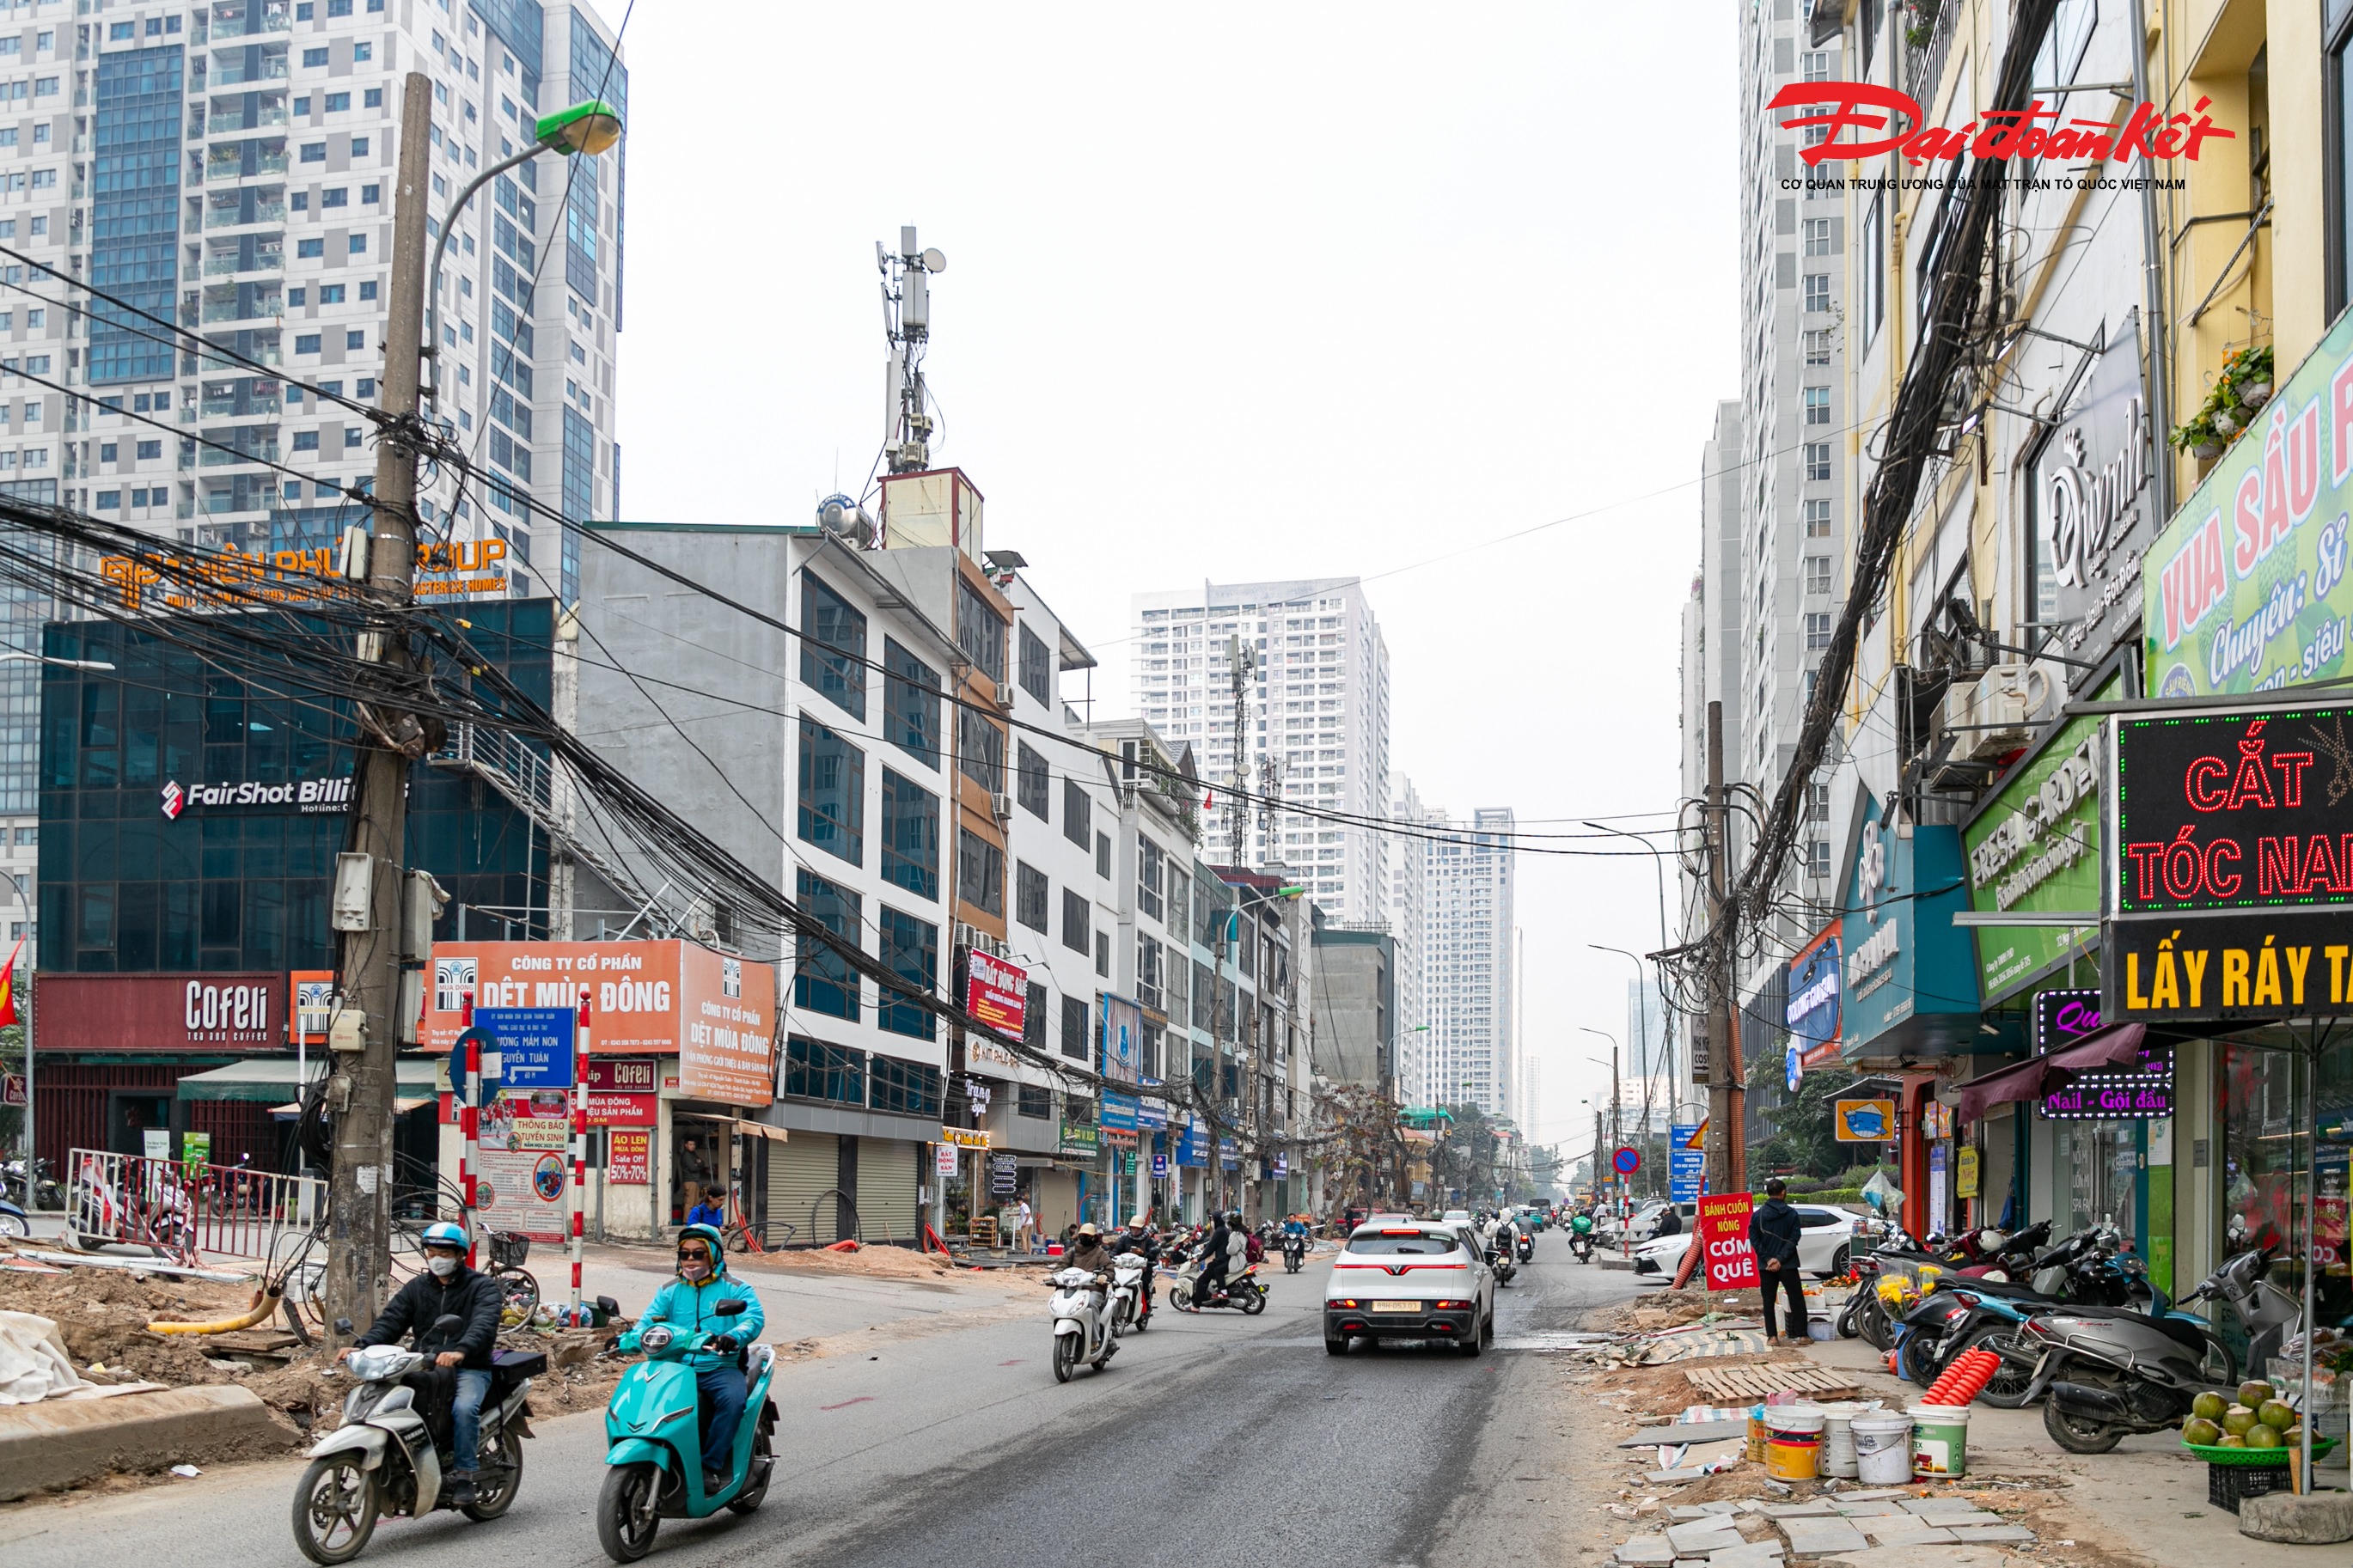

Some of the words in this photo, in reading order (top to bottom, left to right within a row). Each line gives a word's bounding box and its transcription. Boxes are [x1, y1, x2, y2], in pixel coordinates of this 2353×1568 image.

[2108, 509, 2140, 551] ACADEMY
[2160, 510, 2227, 650] VUA
[2234, 404, 2318, 577] SẦU
[2211, 574, 2306, 686] Chuyên:
[2301, 615, 2344, 679] siêu
[2184, 720, 2314, 813] CẮT
[187, 781, 293, 805] FairShot
[1971, 811, 2025, 889] FRESH
[2127, 824, 2243, 900] TÓC
[511, 955, 552, 970] CÔNG
[556, 957, 573, 970] TY
[577, 953, 597, 970] CỔ
[602, 953, 642, 970] PHẦN
[2127, 930, 2209, 1010] LẤY
[2222, 934, 2312, 1007] RÁY
[186, 980, 267, 1029] Cofeli
[535, 975, 593, 1012] MÙA
[600, 975, 670, 1012] ĐÔNG
[701, 1000, 720, 1018] CÔNG
[722, 1006, 730, 1018] TY
[542, 1036, 559, 1046] NON
[691, 1021, 712, 1048] DỆT
[714, 1026, 739, 1051] MÙA
[741, 1031, 769, 1056] ĐÔNG
[502, 1049, 525, 1064] GUYỄN
[614, 1063, 651, 1083] Cofeli
[589, 1096, 605, 1106] MÙA
[608, 1096, 631, 1106] ĐÔNG
[965, 1079, 991, 1104] Trang
[2047, 1091, 2081, 1109] Nail
[2099, 1090, 2130, 1111] Gội
[2136, 1089, 2167, 1108] đầu
[972, 1098, 987, 1117] Spa
[518, 1119, 546, 1129] THÔNG
[548, 1120, 565, 1131] BÁO
[614, 1133, 628, 1144] ÁO
[631, 1136, 646, 1144] LEN
[1704, 1201, 1726, 1217] BÁNH
[1727, 1199, 1749, 1215] CUỐN
[1717, 1217, 1740, 1233] NÓNG
[1709, 1237, 1751, 1257] CƠM
[1713, 1258, 1754, 1282] QUÊ
